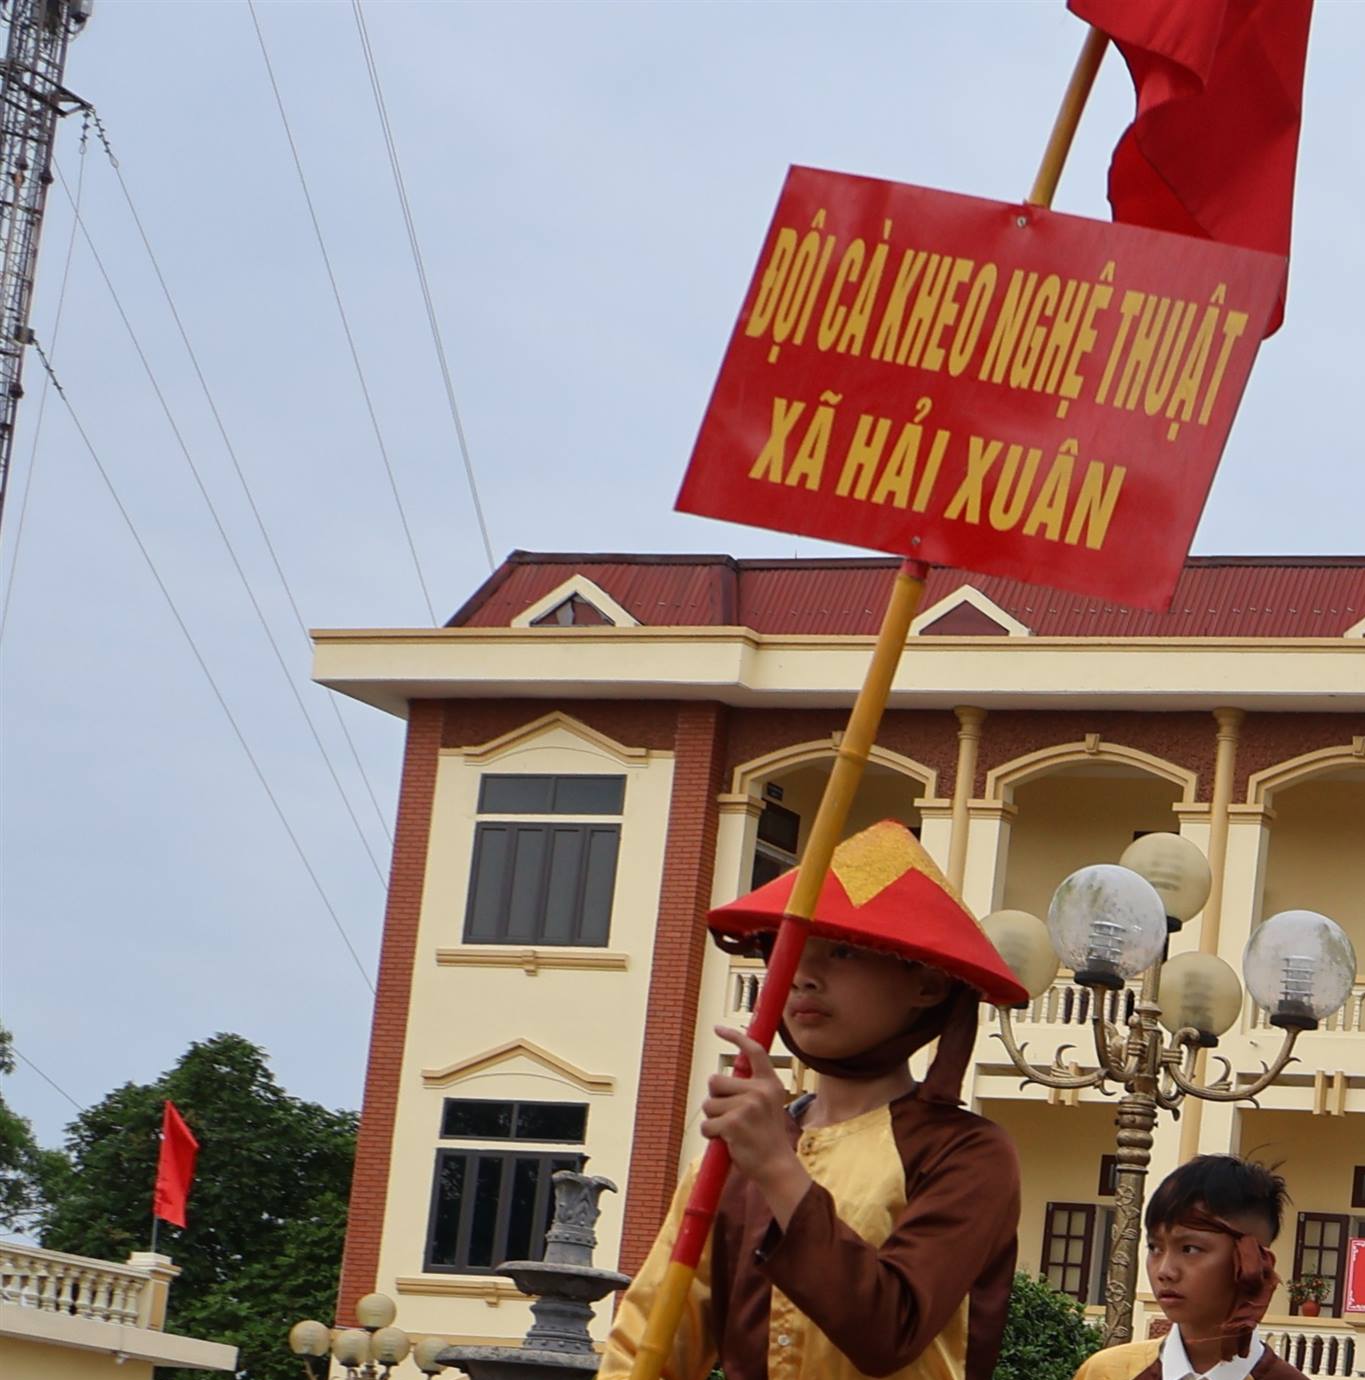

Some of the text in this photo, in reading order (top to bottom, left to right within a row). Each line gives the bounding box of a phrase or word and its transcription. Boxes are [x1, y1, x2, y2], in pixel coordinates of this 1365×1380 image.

[744, 208, 1249, 441] ĐỘI CÀ KHEO NGHỆ THUẬT
[749, 390, 1127, 551] XÃ HẢI XUÂN
